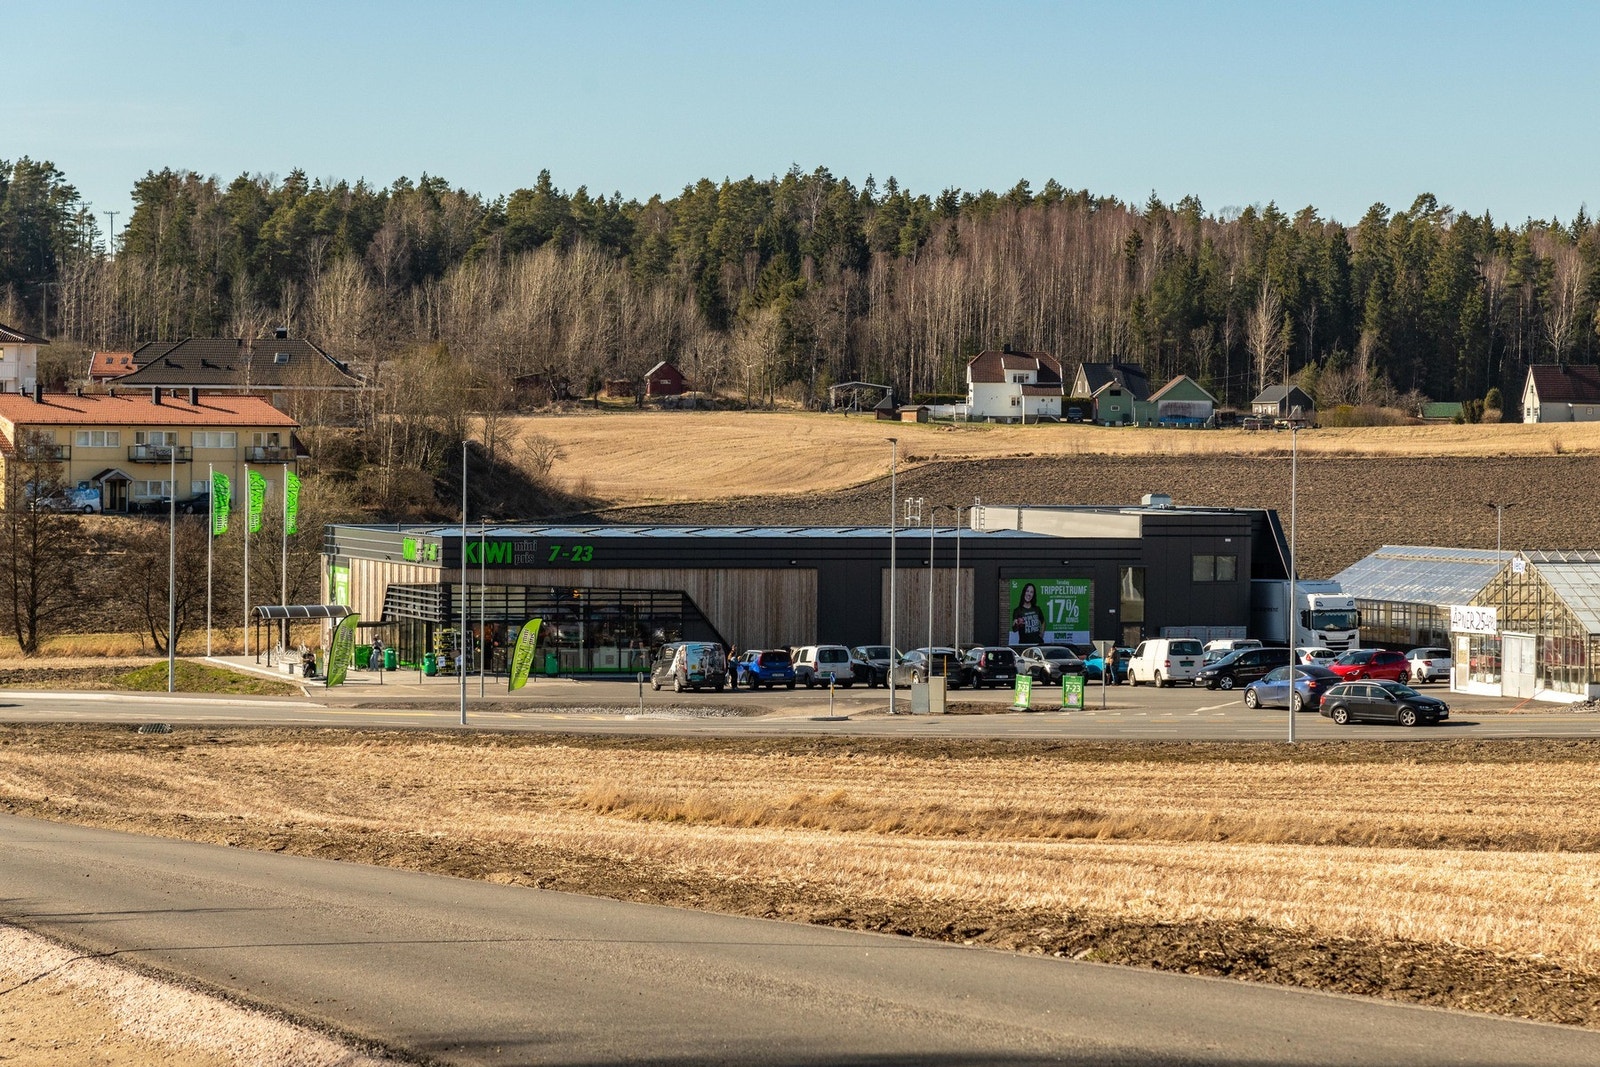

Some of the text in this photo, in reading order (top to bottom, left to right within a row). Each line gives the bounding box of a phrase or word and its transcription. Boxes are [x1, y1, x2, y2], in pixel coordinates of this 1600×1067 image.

[514, 540, 538, 551] mini
[464, 541, 513, 565] KIWI
[514, 552, 535, 565] pris
[1040, 586, 1087, 595] TRIPPELTRUMF
[1046, 599, 1079, 623] 17%
[1452, 607, 1475, 631] ÅPNER
[1065, 684, 1081, 693] 7-23
